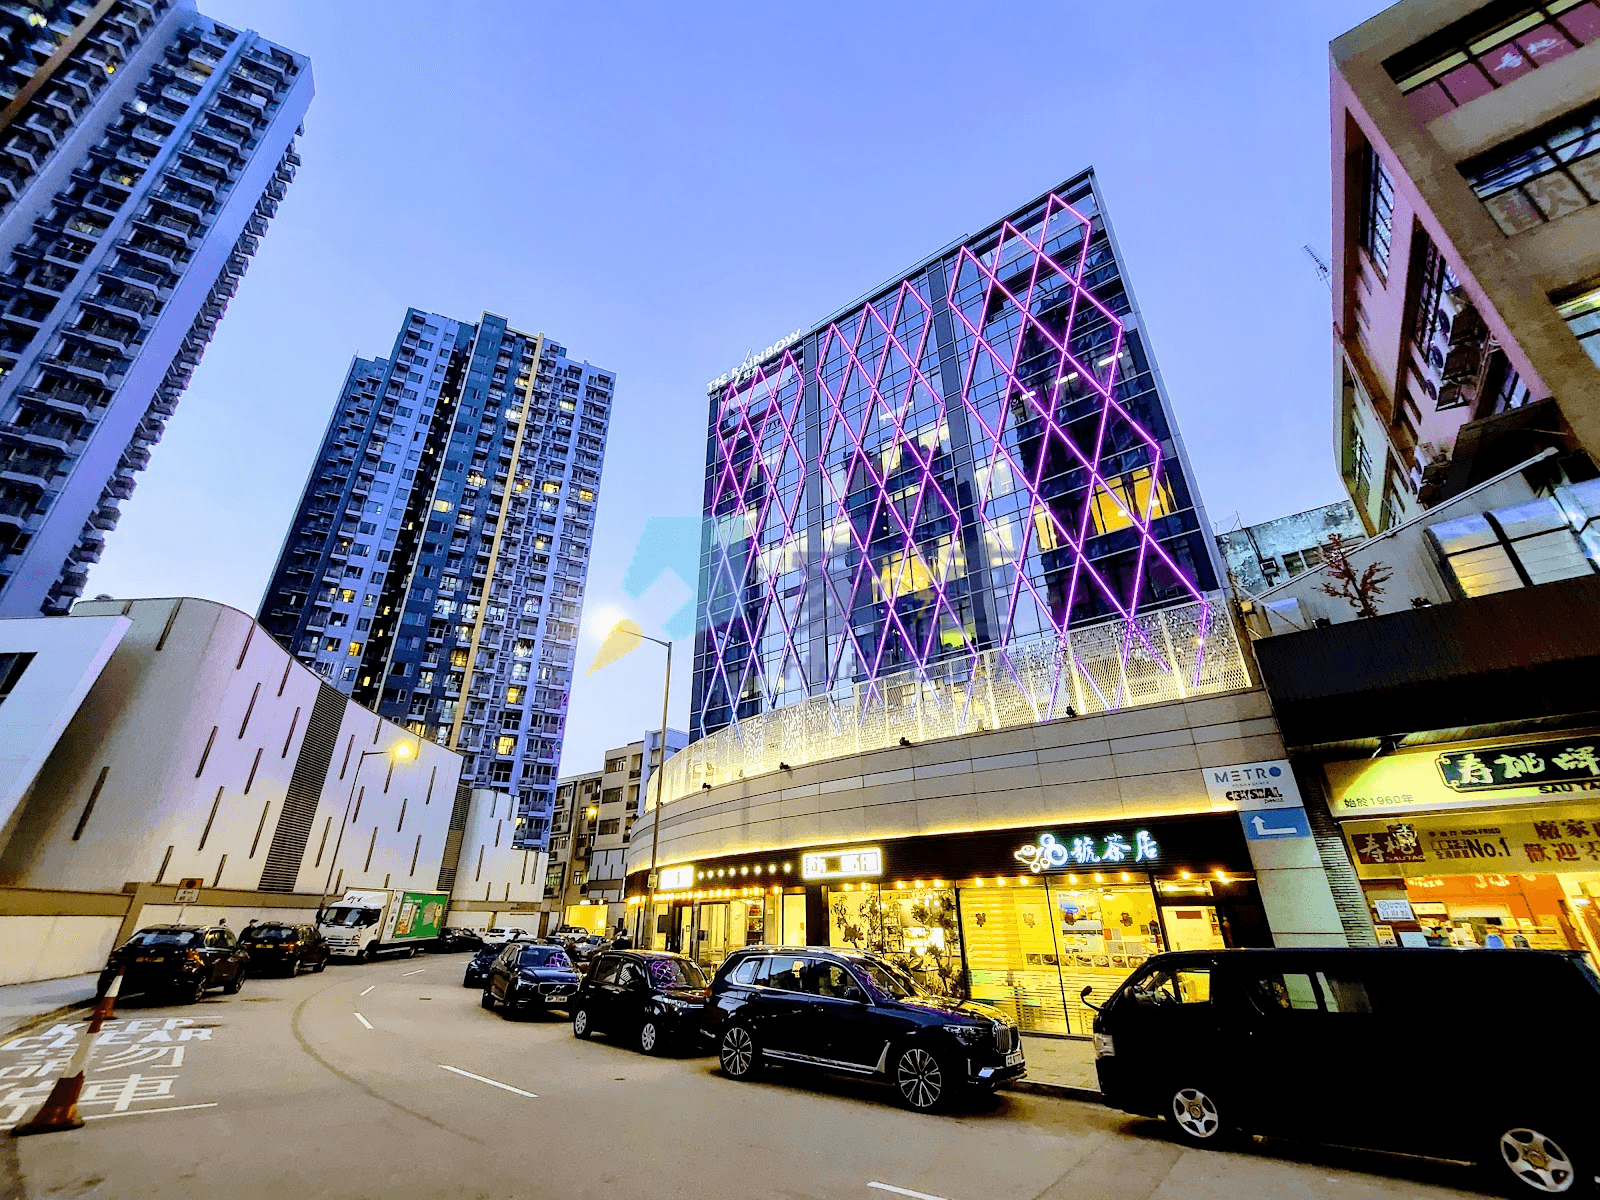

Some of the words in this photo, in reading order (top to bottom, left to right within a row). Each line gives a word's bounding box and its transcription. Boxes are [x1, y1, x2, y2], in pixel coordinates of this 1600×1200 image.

[706, 372, 728, 391] THE
[731, 328, 801, 382] RAINBOW
[1214, 767, 1281, 783] METRO
[1466, 837, 1511, 858] No.1
[0, 1029, 213, 1050] CLEAR
[39, 1018, 194, 1041] KEEP
